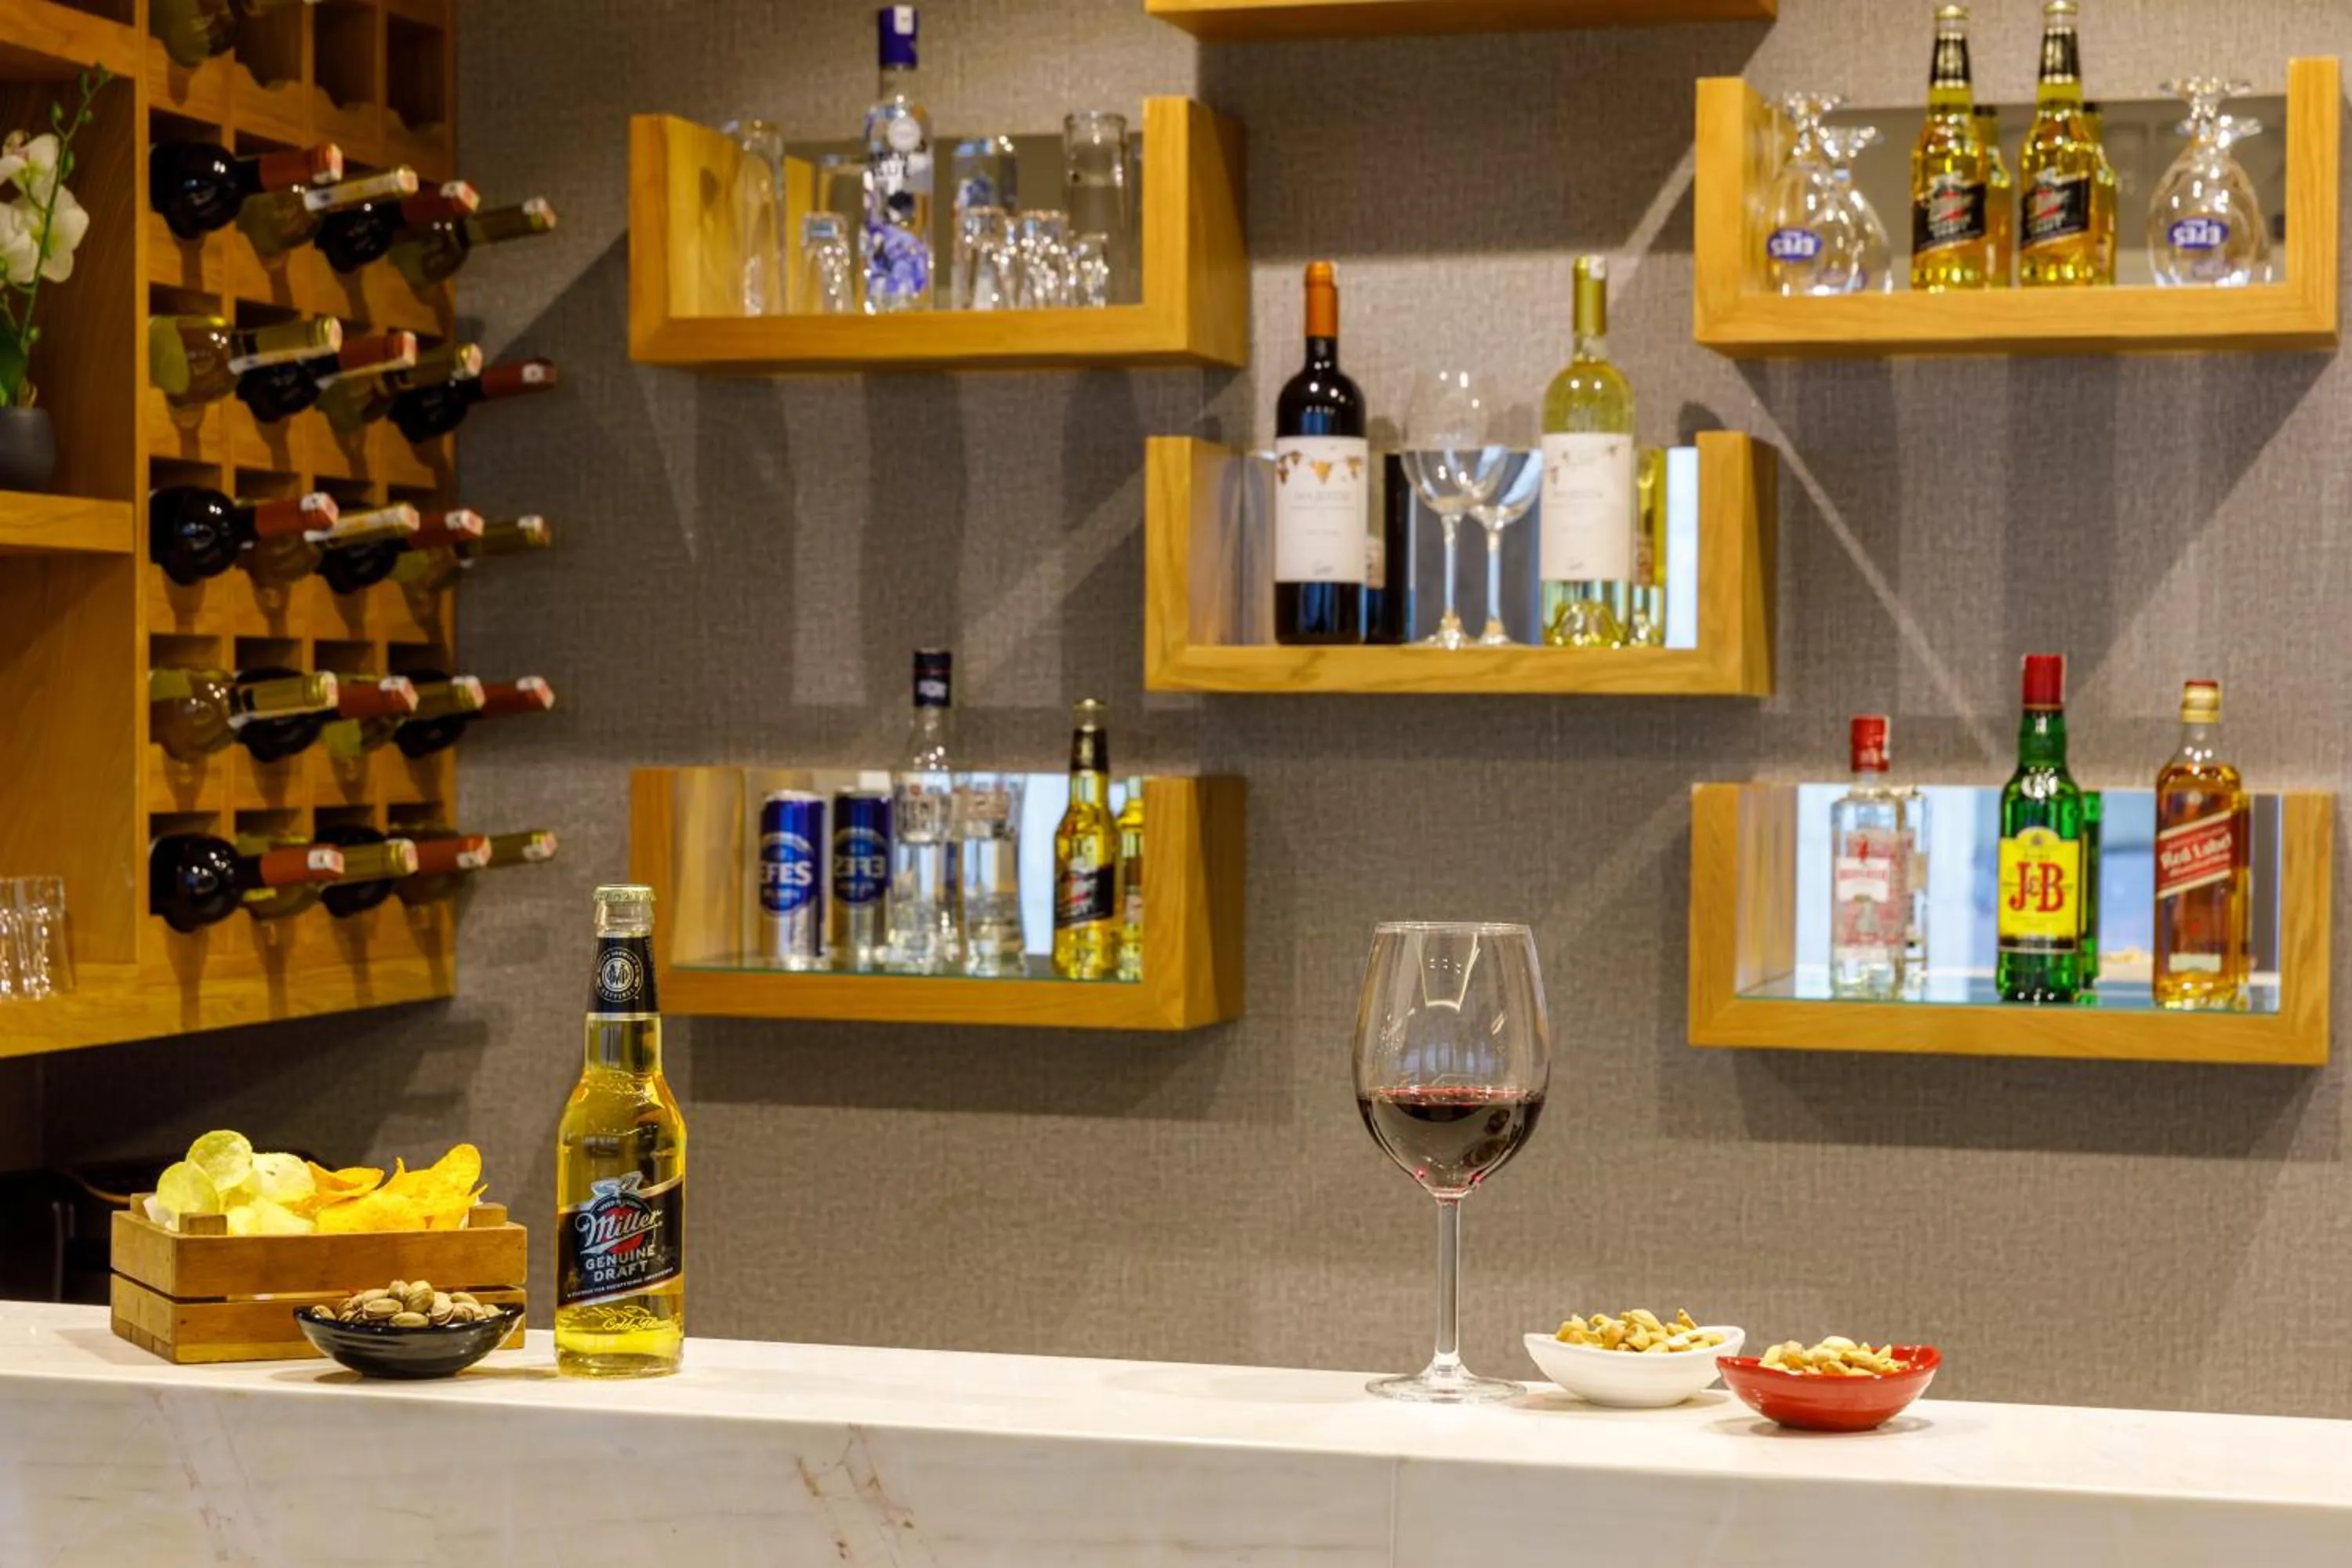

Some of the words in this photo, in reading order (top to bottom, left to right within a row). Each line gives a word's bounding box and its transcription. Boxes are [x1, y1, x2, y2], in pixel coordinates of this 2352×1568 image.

[575, 1209, 663, 1247] Miller
[585, 1244, 655, 1271] GENUINE
[593, 1259, 648, 1282] DRAFT
